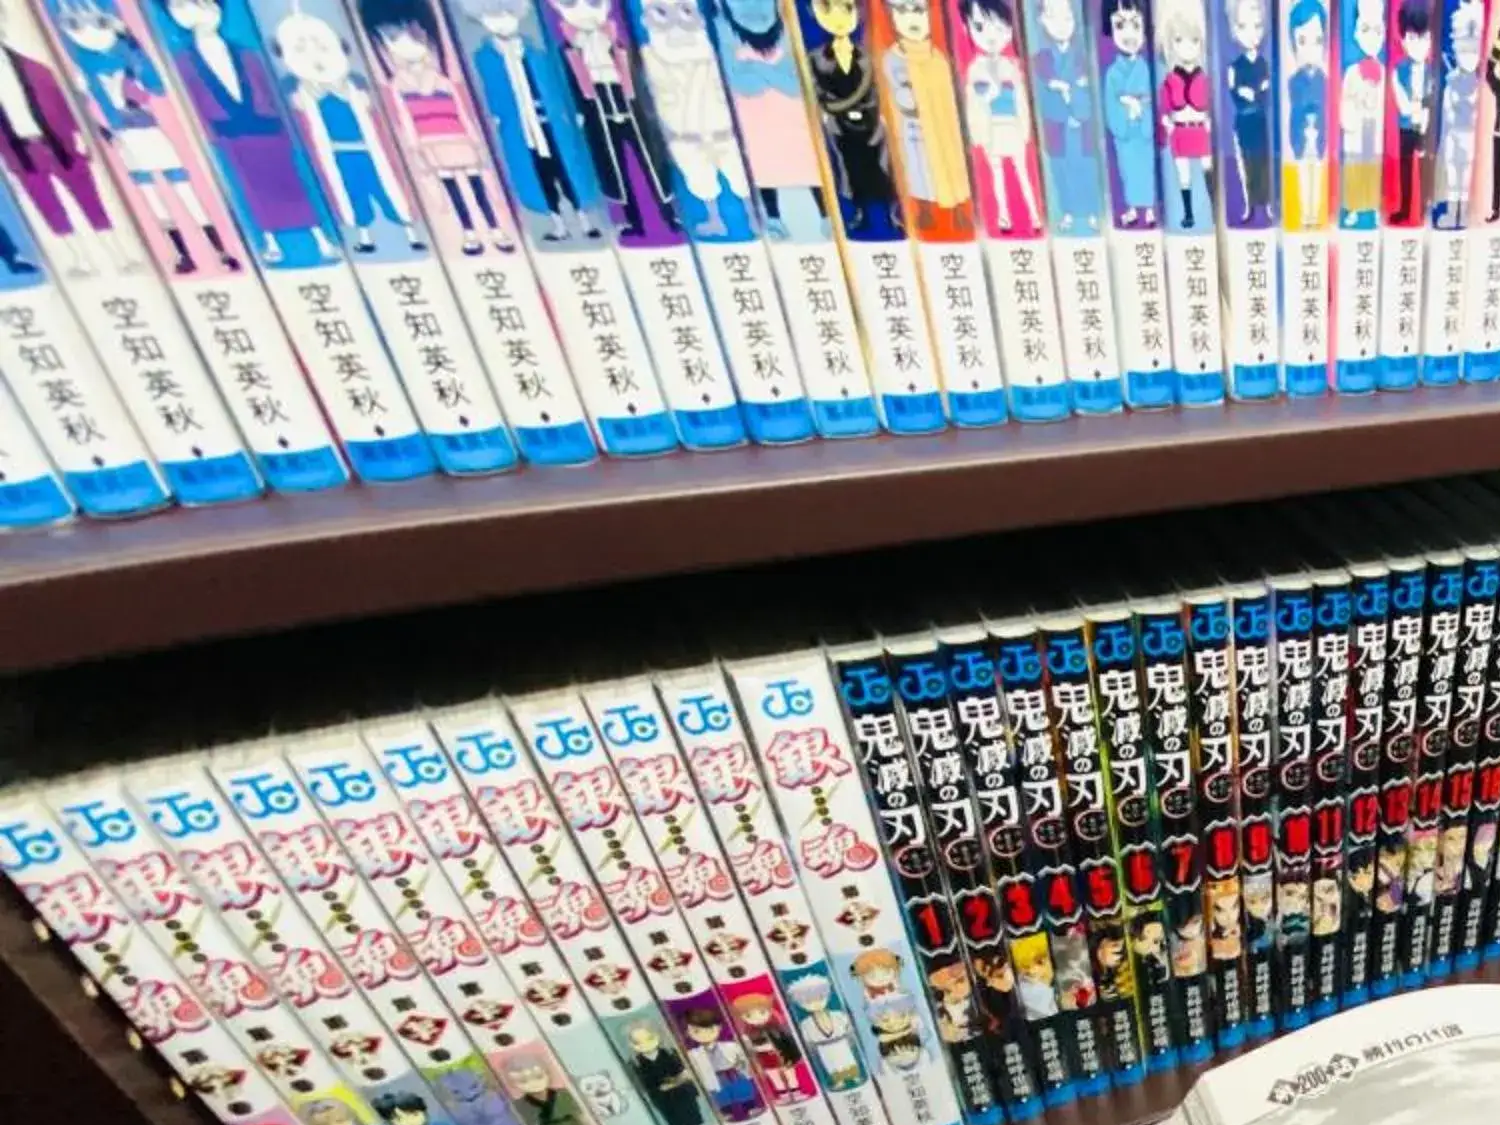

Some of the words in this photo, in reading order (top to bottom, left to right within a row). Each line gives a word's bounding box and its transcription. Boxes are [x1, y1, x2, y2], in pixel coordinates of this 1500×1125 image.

[101, 296, 204, 435] 空知英秋
[196, 290, 291, 426] 空知英秋
[298, 282, 388, 417] 空知英秋
[389, 274, 472, 409] 空知英秋
[475, 268, 554, 401] 空知英秋
[569, 265, 640, 395] 空知英秋
[650, 256, 716, 387] 空知英秋
[723, 251, 785, 380] 空知英秋
[800, 253, 854, 377] 空知英秋
[872, 252, 921, 372] 空知英秋
[941, 253, 983, 370] 空知英秋
[1010, 248, 1049, 363] 空知英秋
[1073, 248, 1108, 361] 空知英秋
[0, 305, 107, 445] 空知英秋
[1194, 649, 1232, 772] 鬼滅の刃
[1236, 647, 1271, 766] 鬼滅の刃
[1279, 640, 1310, 759] 鬼滅の刃
[1316, 634, 1348, 753] 鬼滅の刃
[1354, 624, 1385, 742] 鬼滅の刃
[1387, 616, 1422, 735] 鬼滅の刃
[1422, 612, 1458, 730] 鬼滅の刃
[1455, 604, 1494, 718] 鬼滅の刃
[854, 715, 925, 845] 鬼滅の刃
[910, 709, 974, 838] 鬼滅の刃
[959, 697, 1018, 827] 鬼滅の刃
[1006, 690, 1063, 819] 鬼滅の刃
[1052, 683, 1101, 809] 鬼滅の刃
[1100, 670, 1145, 796] 鬼滅の刃
[1147, 664, 1190, 789] 鬼滅の刃
[477, 780, 611, 939] 銀魂
[553, 766, 675, 924] 銀魂
[618, 753, 736, 908] 銀魂
[691, 742, 795, 896] 銀魂
[766, 728, 879, 879] 銀魂
[1172, 844, 1193, 884] 7
[1318, 807, 1342, 846] 11
[1354, 794, 1377, 833] 12
[94, 850, 280, 1018] 銀魂
[179, 841, 353, 1007] 銀魂
[258, 824, 426, 989] 銀魂
[334, 812, 490, 976] 銀魂
[405, 796, 546, 954] 銀魂
[918, 905, 942, 947] 1
[963, 896, 993, 940] 2
[1003, 879, 1035, 926] 3
[1049, 875, 1075, 914] 4
[1088, 869, 1114, 908] 5
[16, 871, 211, 1043] 銀魂
